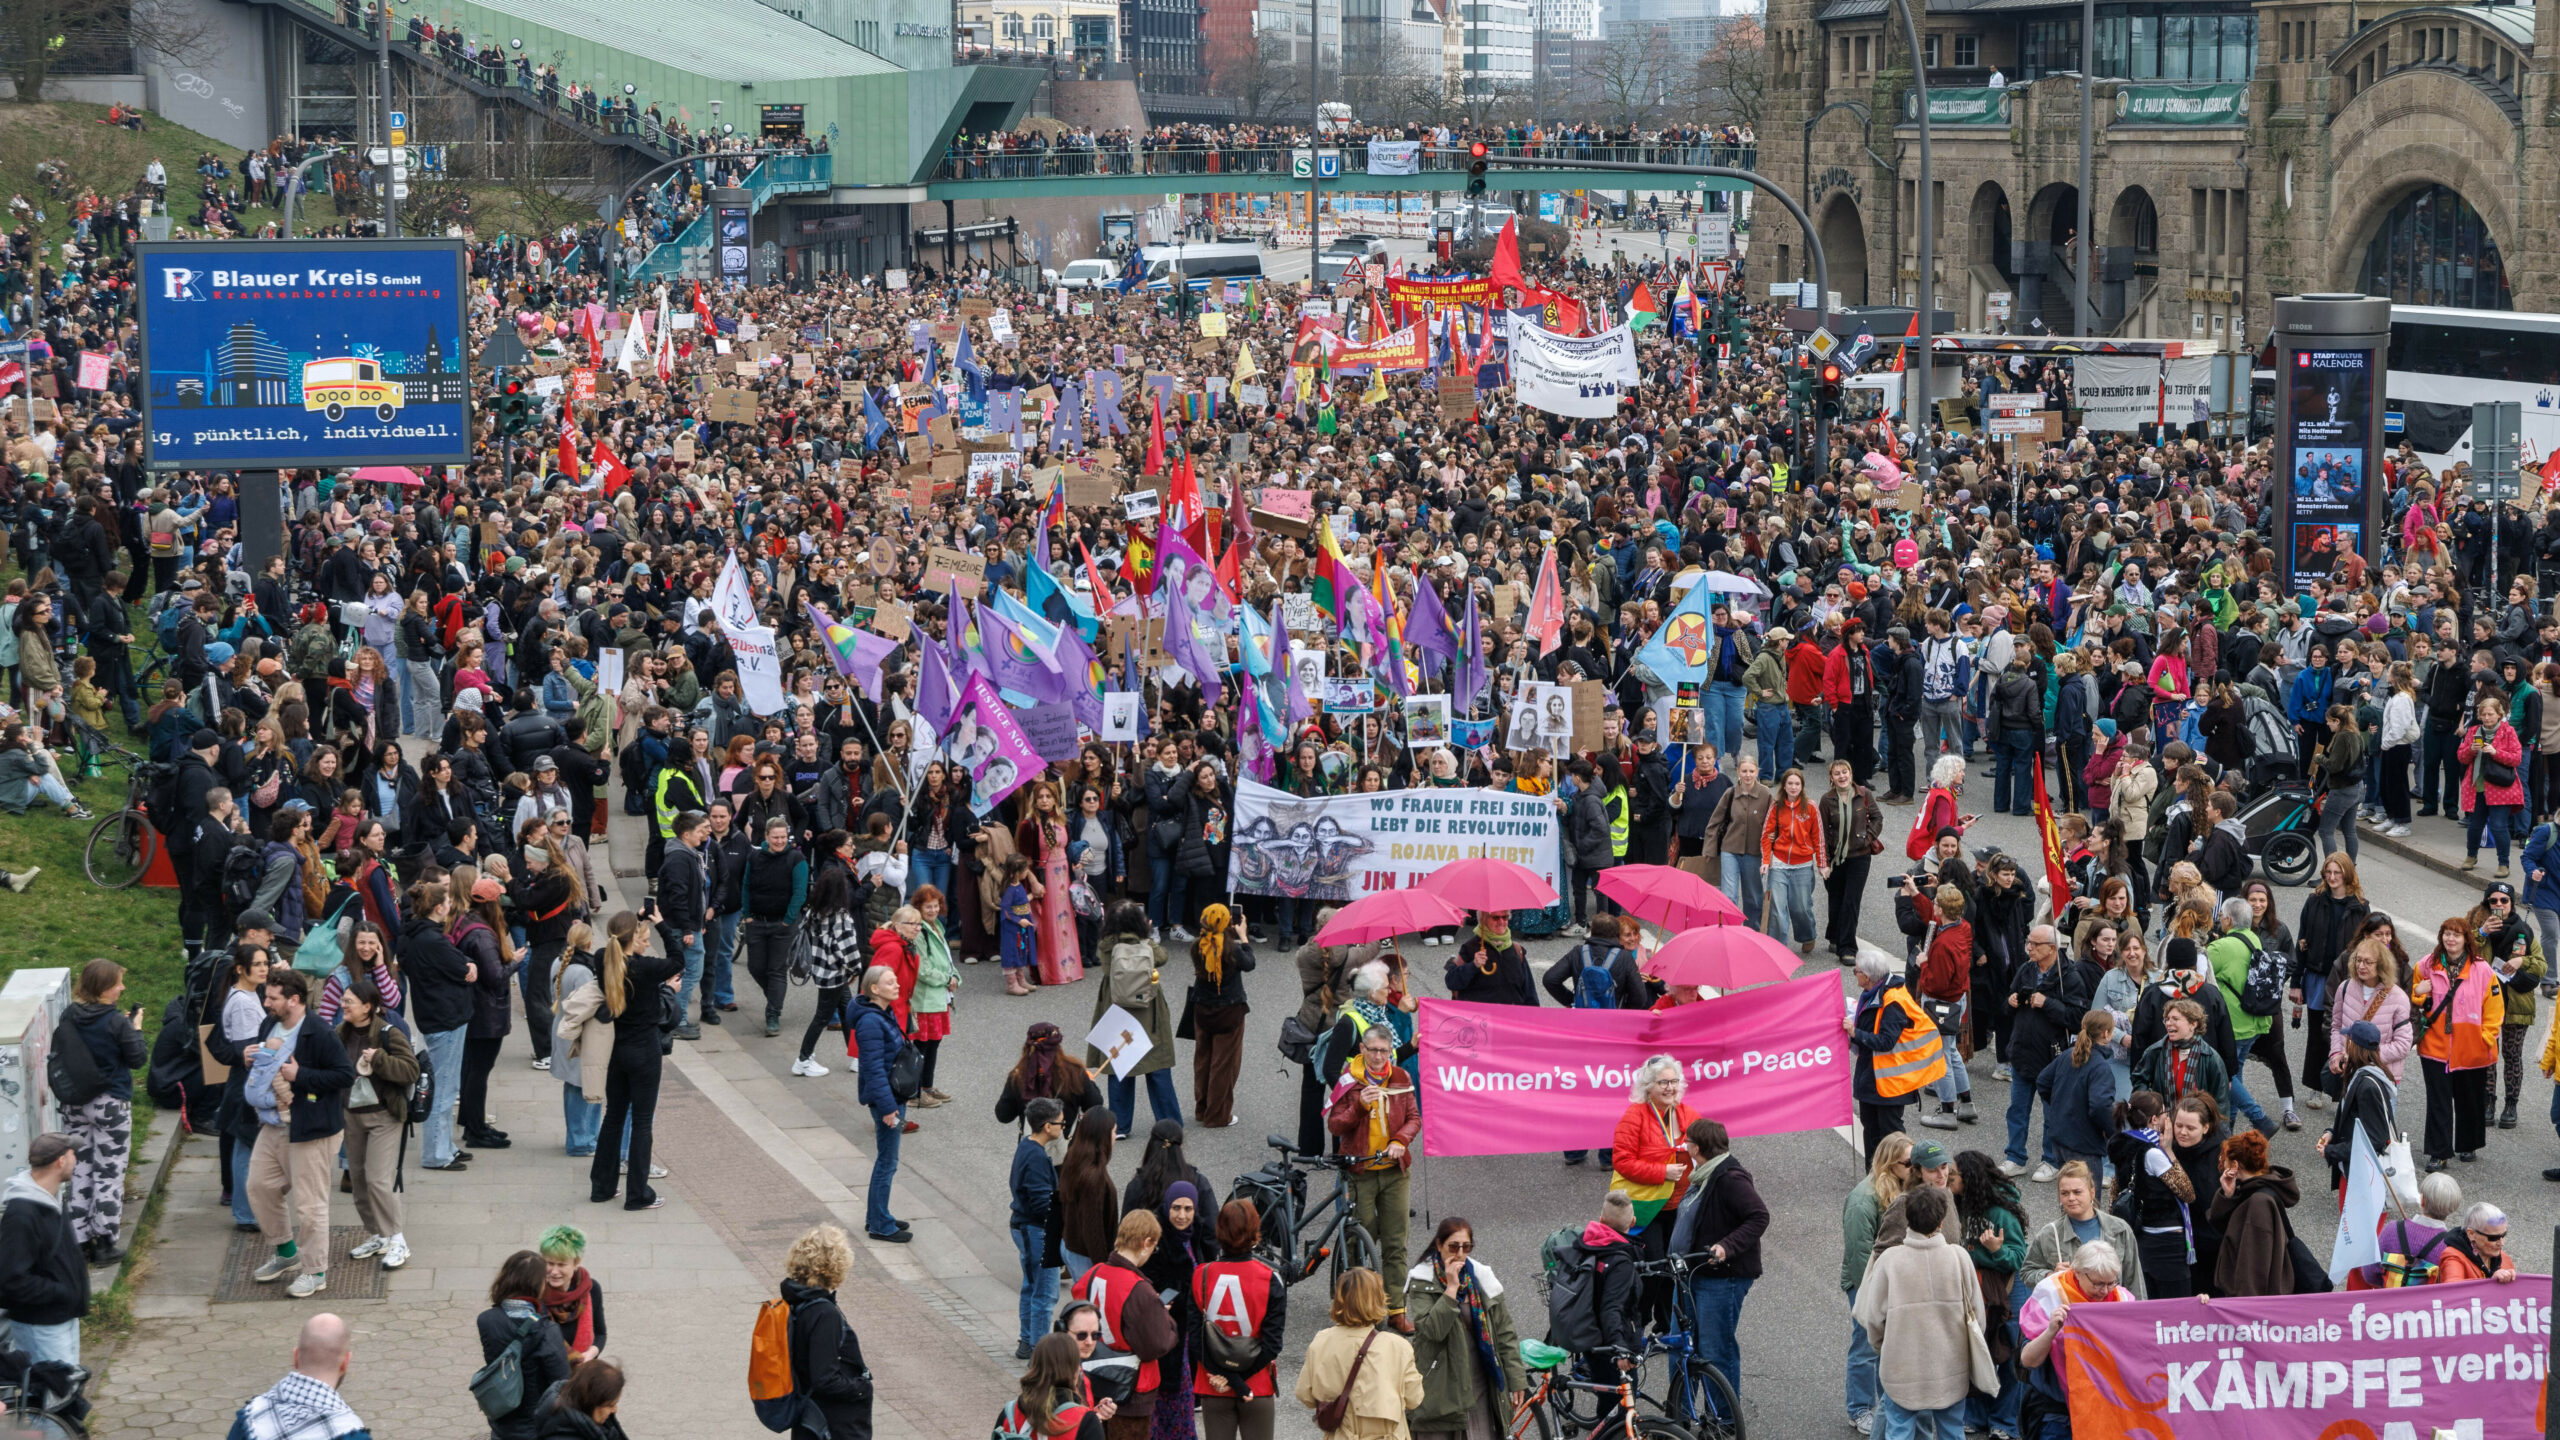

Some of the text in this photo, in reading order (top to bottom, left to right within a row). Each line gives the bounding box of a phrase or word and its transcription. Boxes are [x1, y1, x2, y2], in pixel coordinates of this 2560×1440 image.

[2133, 98, 2143, 113] ST.
[2165, 95, 2201, 113] SCHÖNSTER
[2202, 97, 2233, 113] AUSBLICK
[1320, 158, 1337, 176] U
[212, 269, 421, 287] Blauer Kreis GmbH
[213, 288, 440, 300] Krankenbeförderung
[1400, 284, 1430, 294] HERAUS
[1432, 286, 1449, 294] ZUM
[1462, 282, 1488, 293] MÄRZ!
[1390, 293, 1405, 302] FÜR
[1406, 294, 1422, 302] EINE
[2288, 323, 2313, 331] STRÖER
[1405, 358, 1424, 366] MLPD
[2312, 359, 2364, 368] KALENDER
[194, 427, 309, 444] pünktlich,
[323, 424, 458, 439] individuell.
[934, 554, 984, 576] FEMIZIDE
[1677, 698, 1698, 706] Azadi
[973, 682, 1032, 757] JUSTICE NOW
[1370, 798, 1552, 819] WO FRAUEN FREI SIND,
[1371, 817, 1548, 836] LEBT DIE REVOLUTION!
[1391, 843, 1460, 861] ROJAVA
[1361, 870, 1397, 891] JIN
[1691, 1057, 1733, 1082] for
[1742, 1045, 1832, 1076] Peace
[1206, 1273, 1253, 1337] A
[2155, 1297, 2551, 1345] internationale feministis
[2166, 1343, 2549, 1413] KÄMPFE verbi
